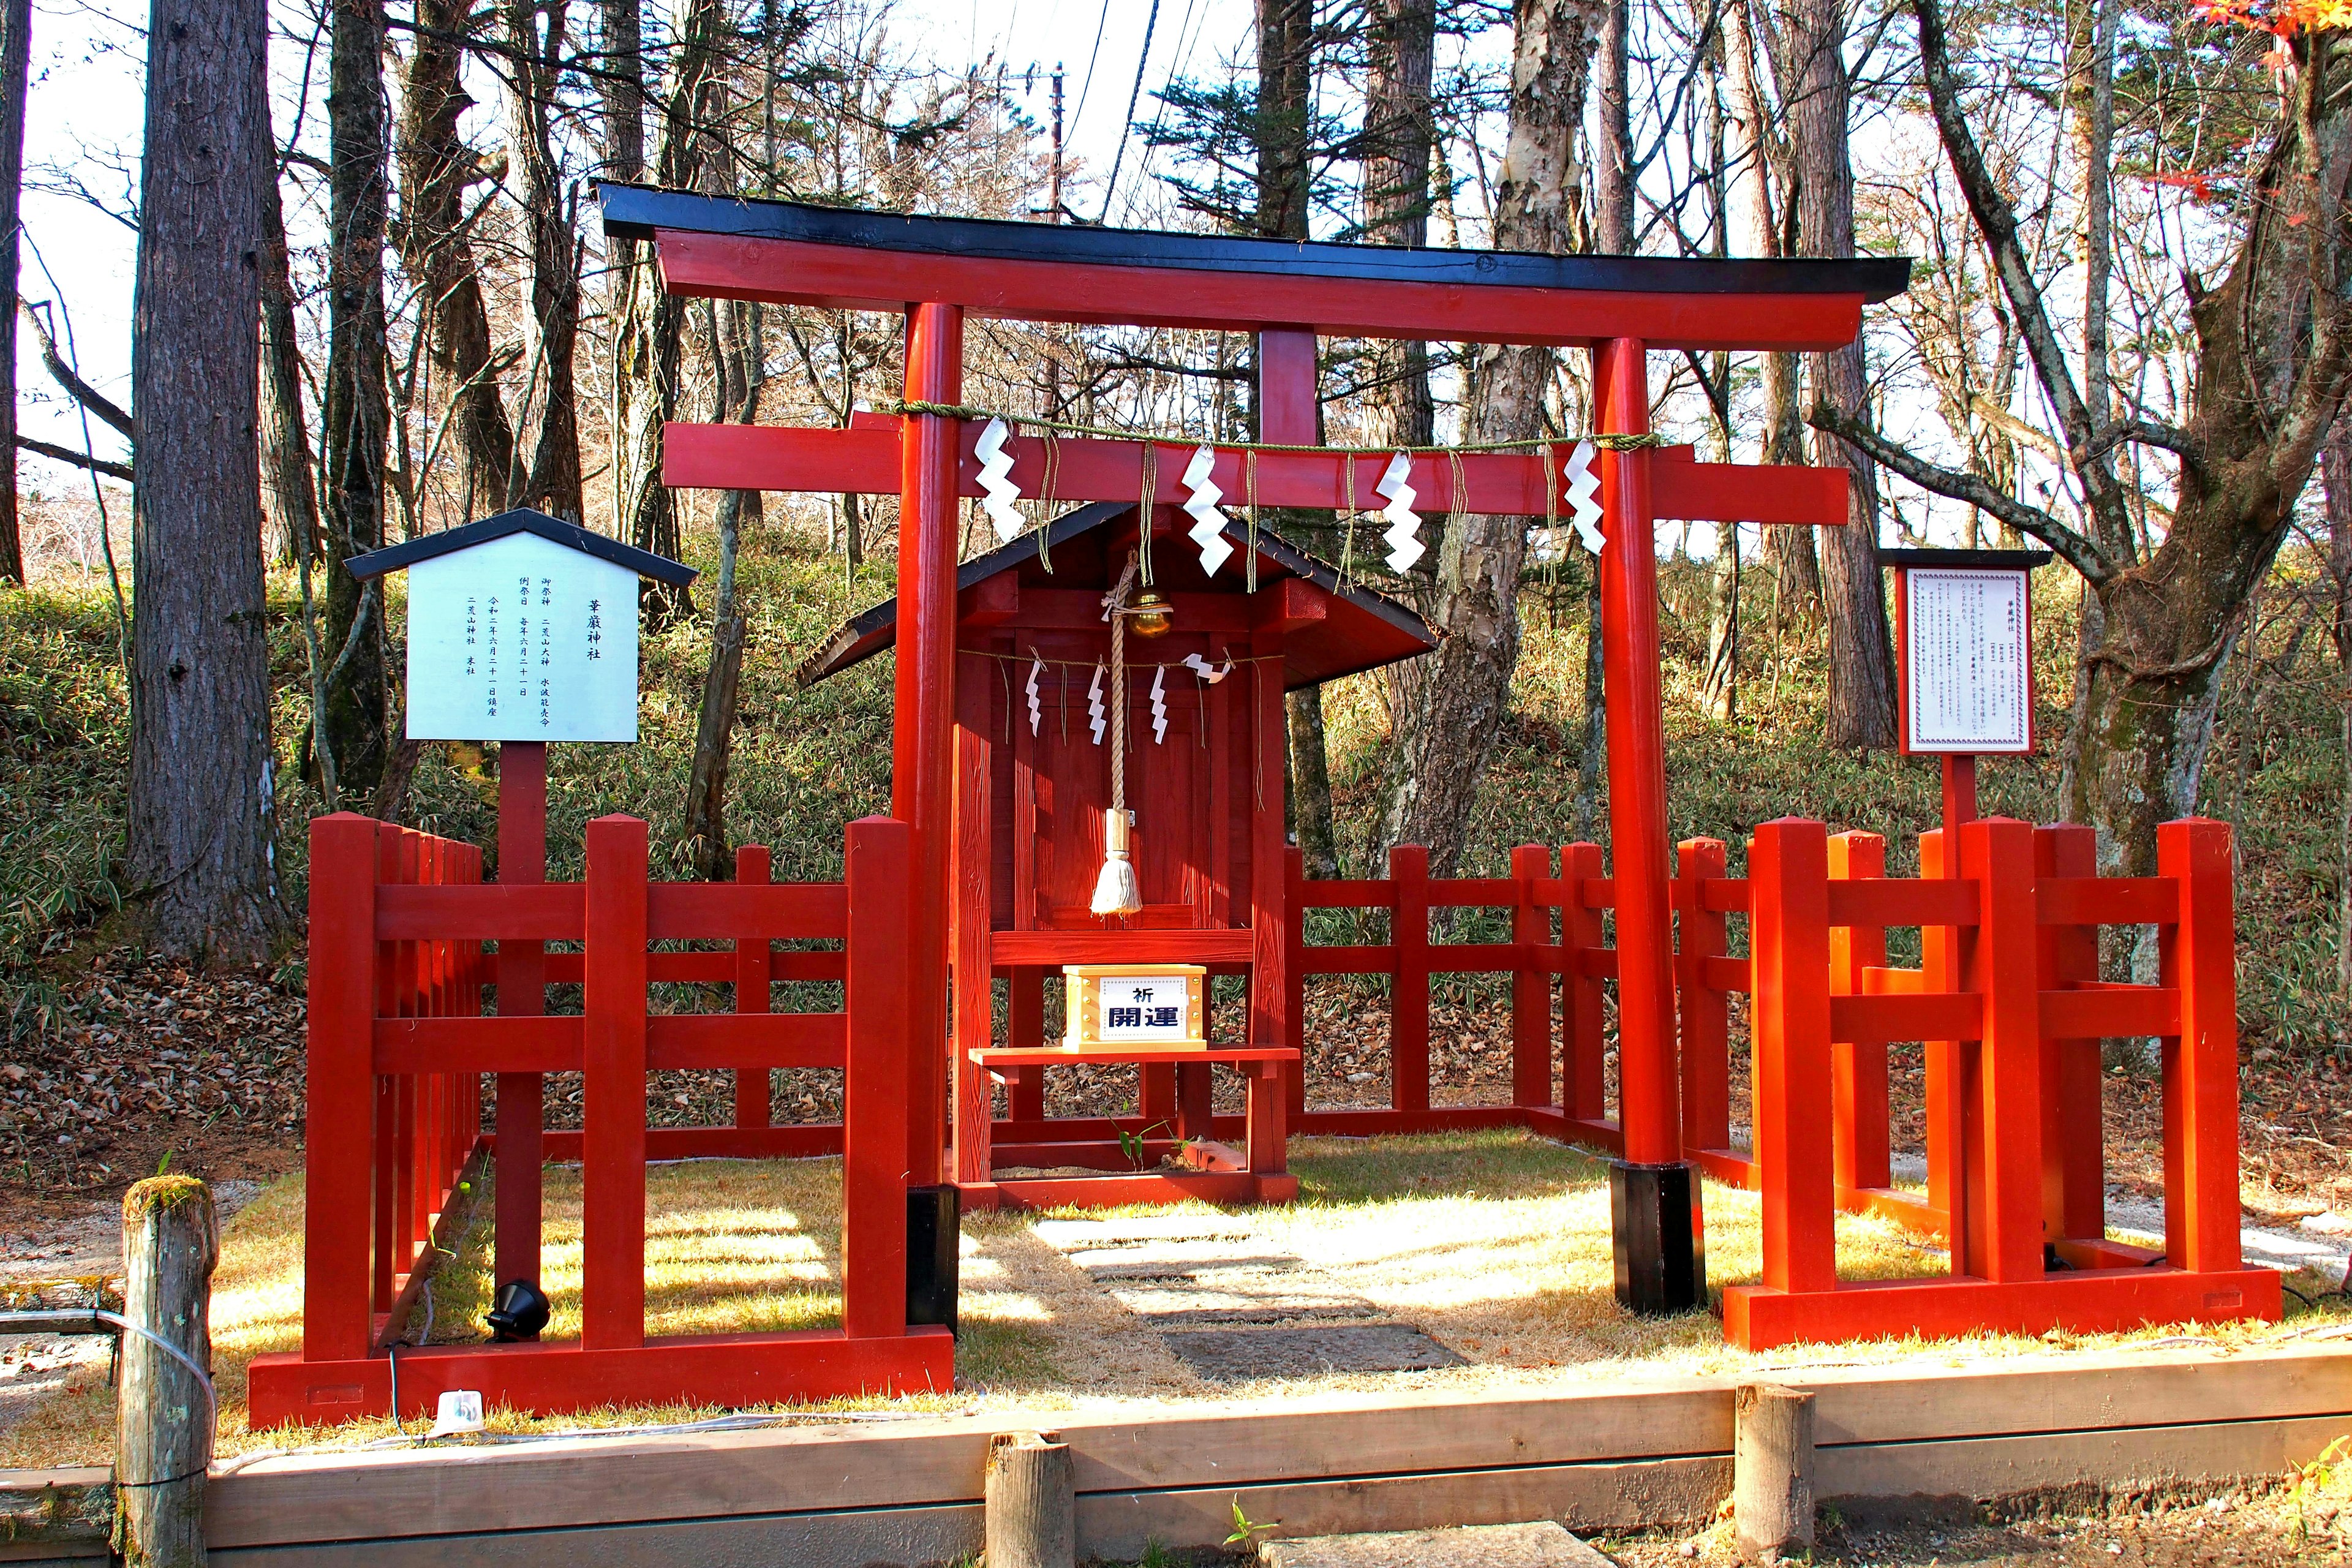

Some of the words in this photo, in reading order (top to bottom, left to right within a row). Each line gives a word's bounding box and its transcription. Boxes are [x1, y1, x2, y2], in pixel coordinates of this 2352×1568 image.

[519, 576, 530, 606] 例祭日
[541, 578, 551, 606] 御祭神
[466, 597, 477, 646] 二荒山神社
[540, 619, 551, 666] 二荒山大神
[586, 599, 602, 661] 華厳神社
[466, 656, 476, 676] 末社
[487, 596, 499, 717] 令和二年六月二十一日鎮座
[519, 617, 529, 696] 毎年六月二十一日
[540, 678, 551, 728] 水波能売命
[1109, 1006, 1178, 1028] 開運
[1132, 987, 1154, 1003] 祈
